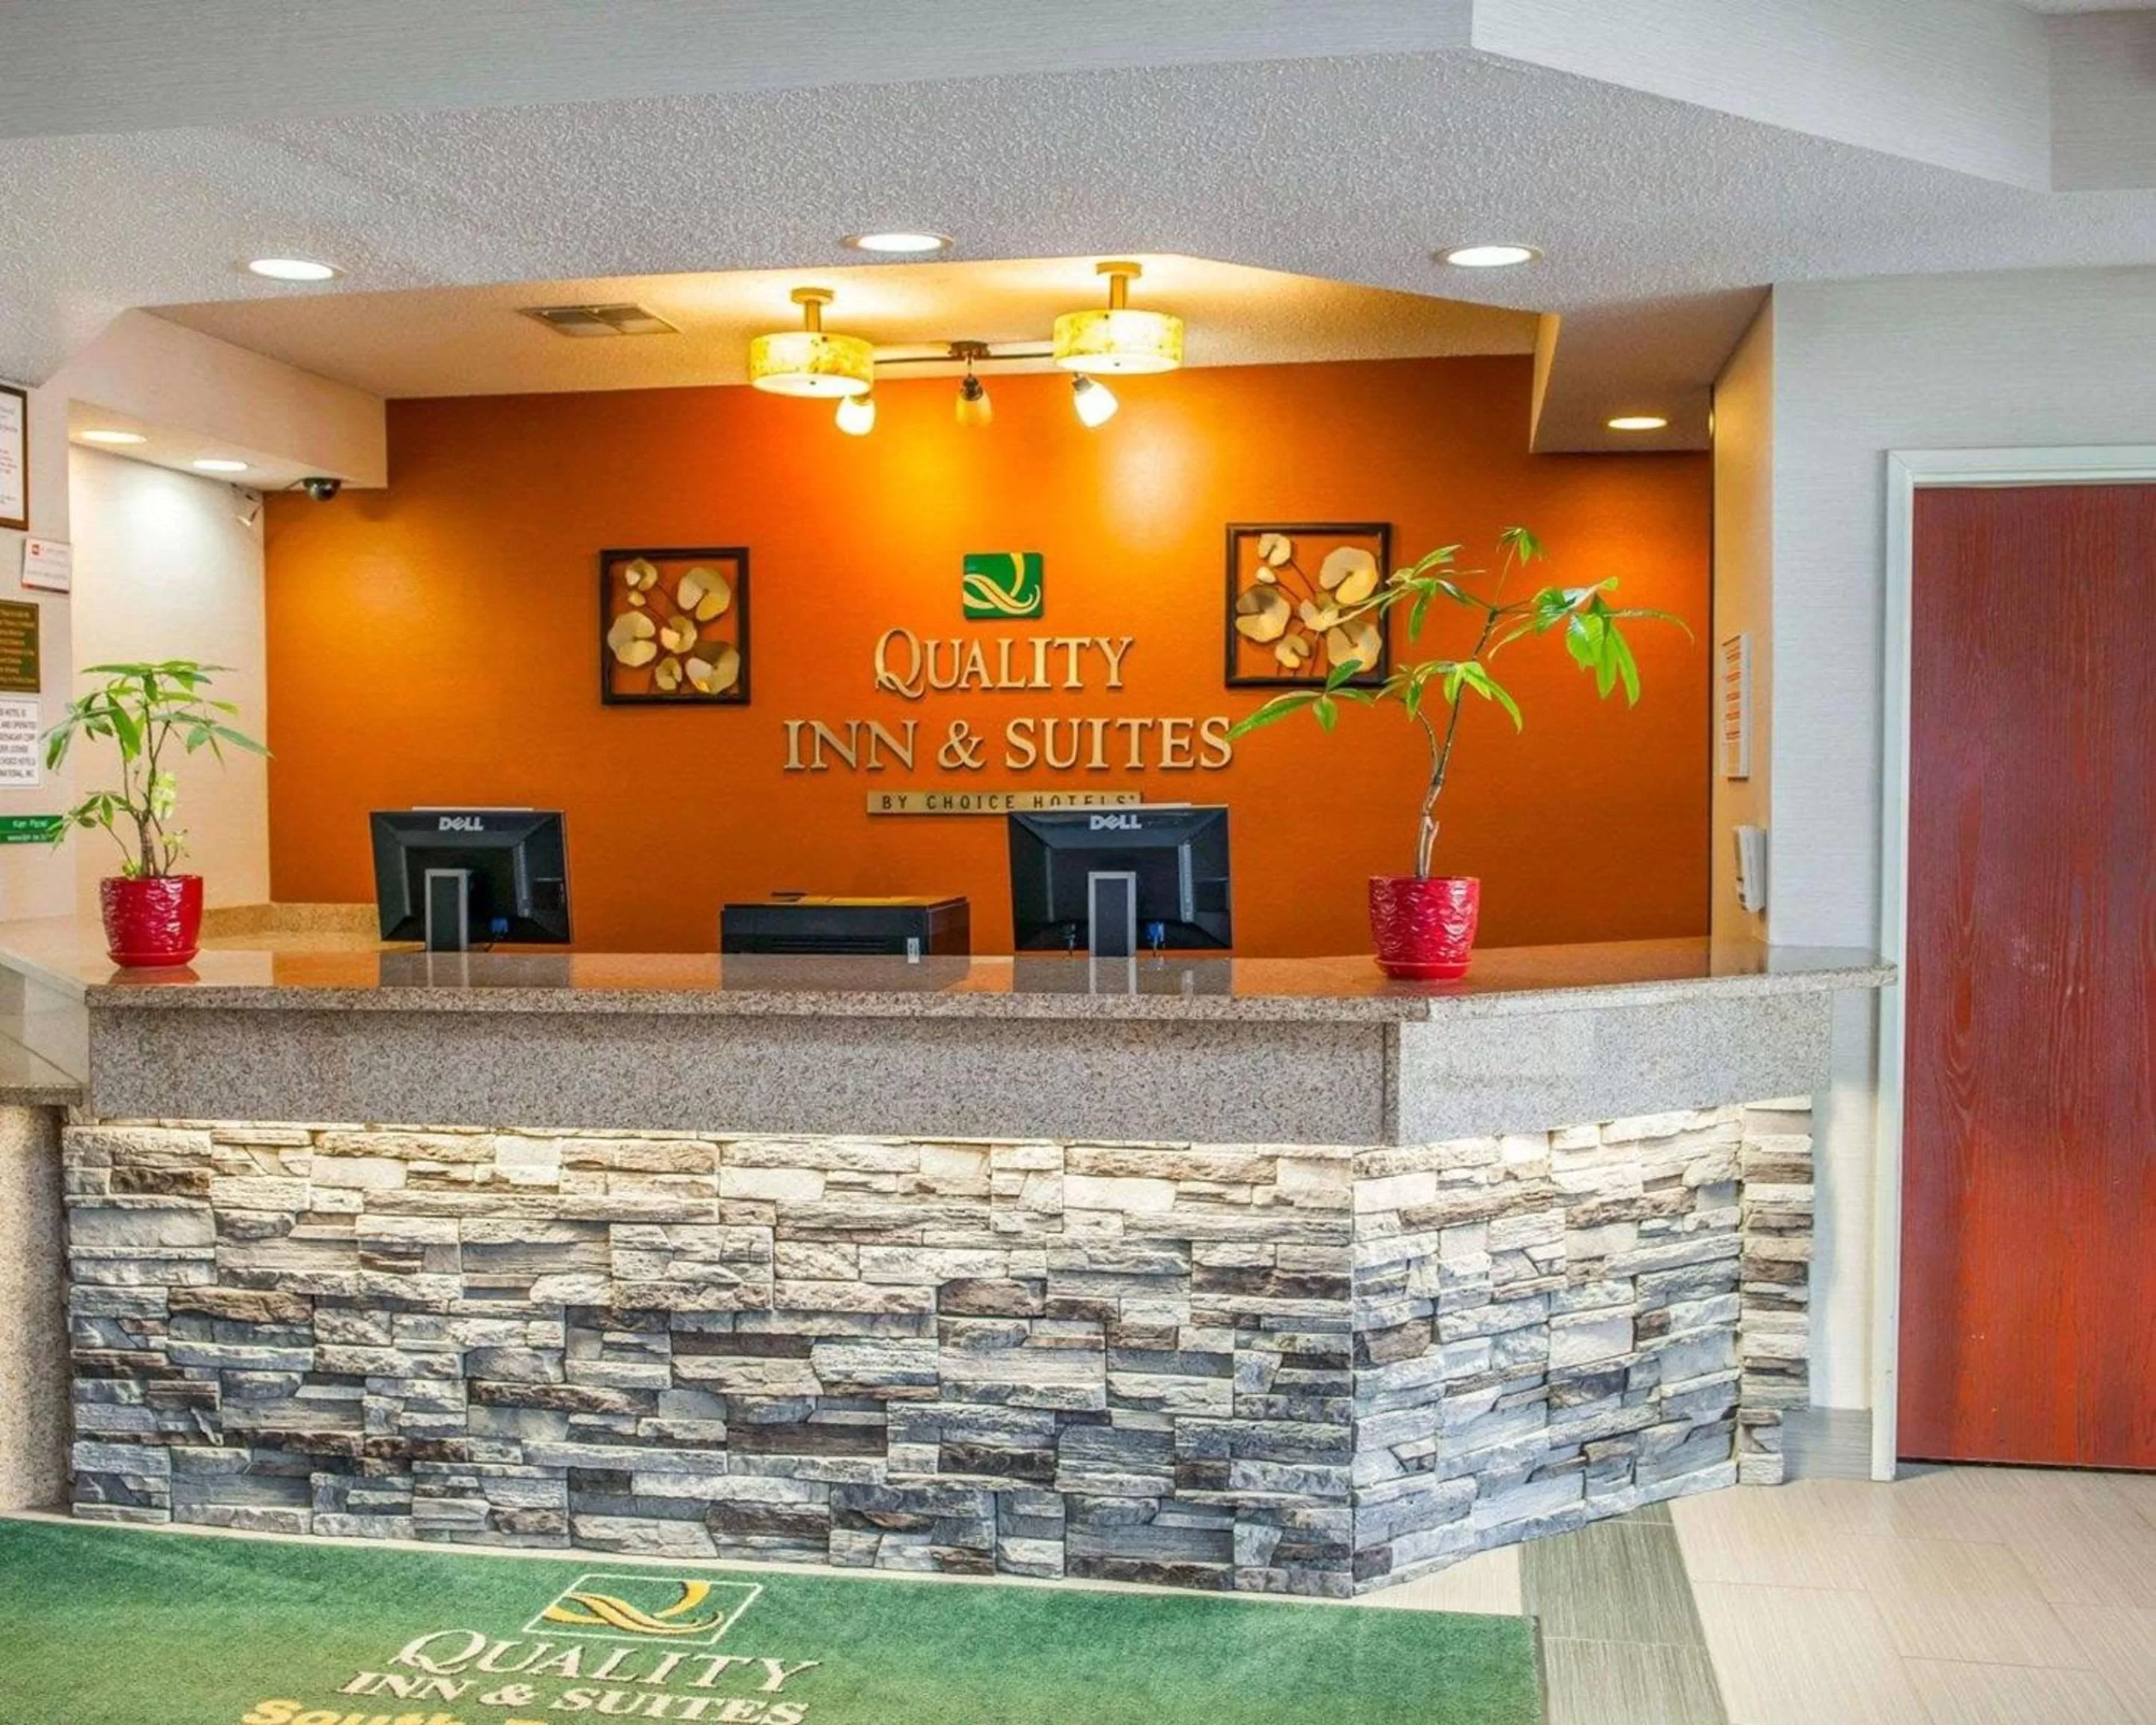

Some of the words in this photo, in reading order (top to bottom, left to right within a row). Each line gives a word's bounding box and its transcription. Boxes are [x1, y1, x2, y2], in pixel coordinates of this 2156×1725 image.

[874, 627, 1134, 699] QUALITY
[783, 719, 918, 770] INN
[937, 719, 987, 770] &
[1005, 717, 1234, 770] SUITES
[439, 816, 484, 831] DELL
[883, 795, 907, 809] BY
[927, 795, 1015, 809] CHOICE
[1090, 815, 1142, 830] DELL
[389, 1629, 821, 1694] QUALITY
[337, 1671, 476, 1703] INN
[478, 1683, 540, 1707] &
[548, 1687, 810, 1725] SUITES
